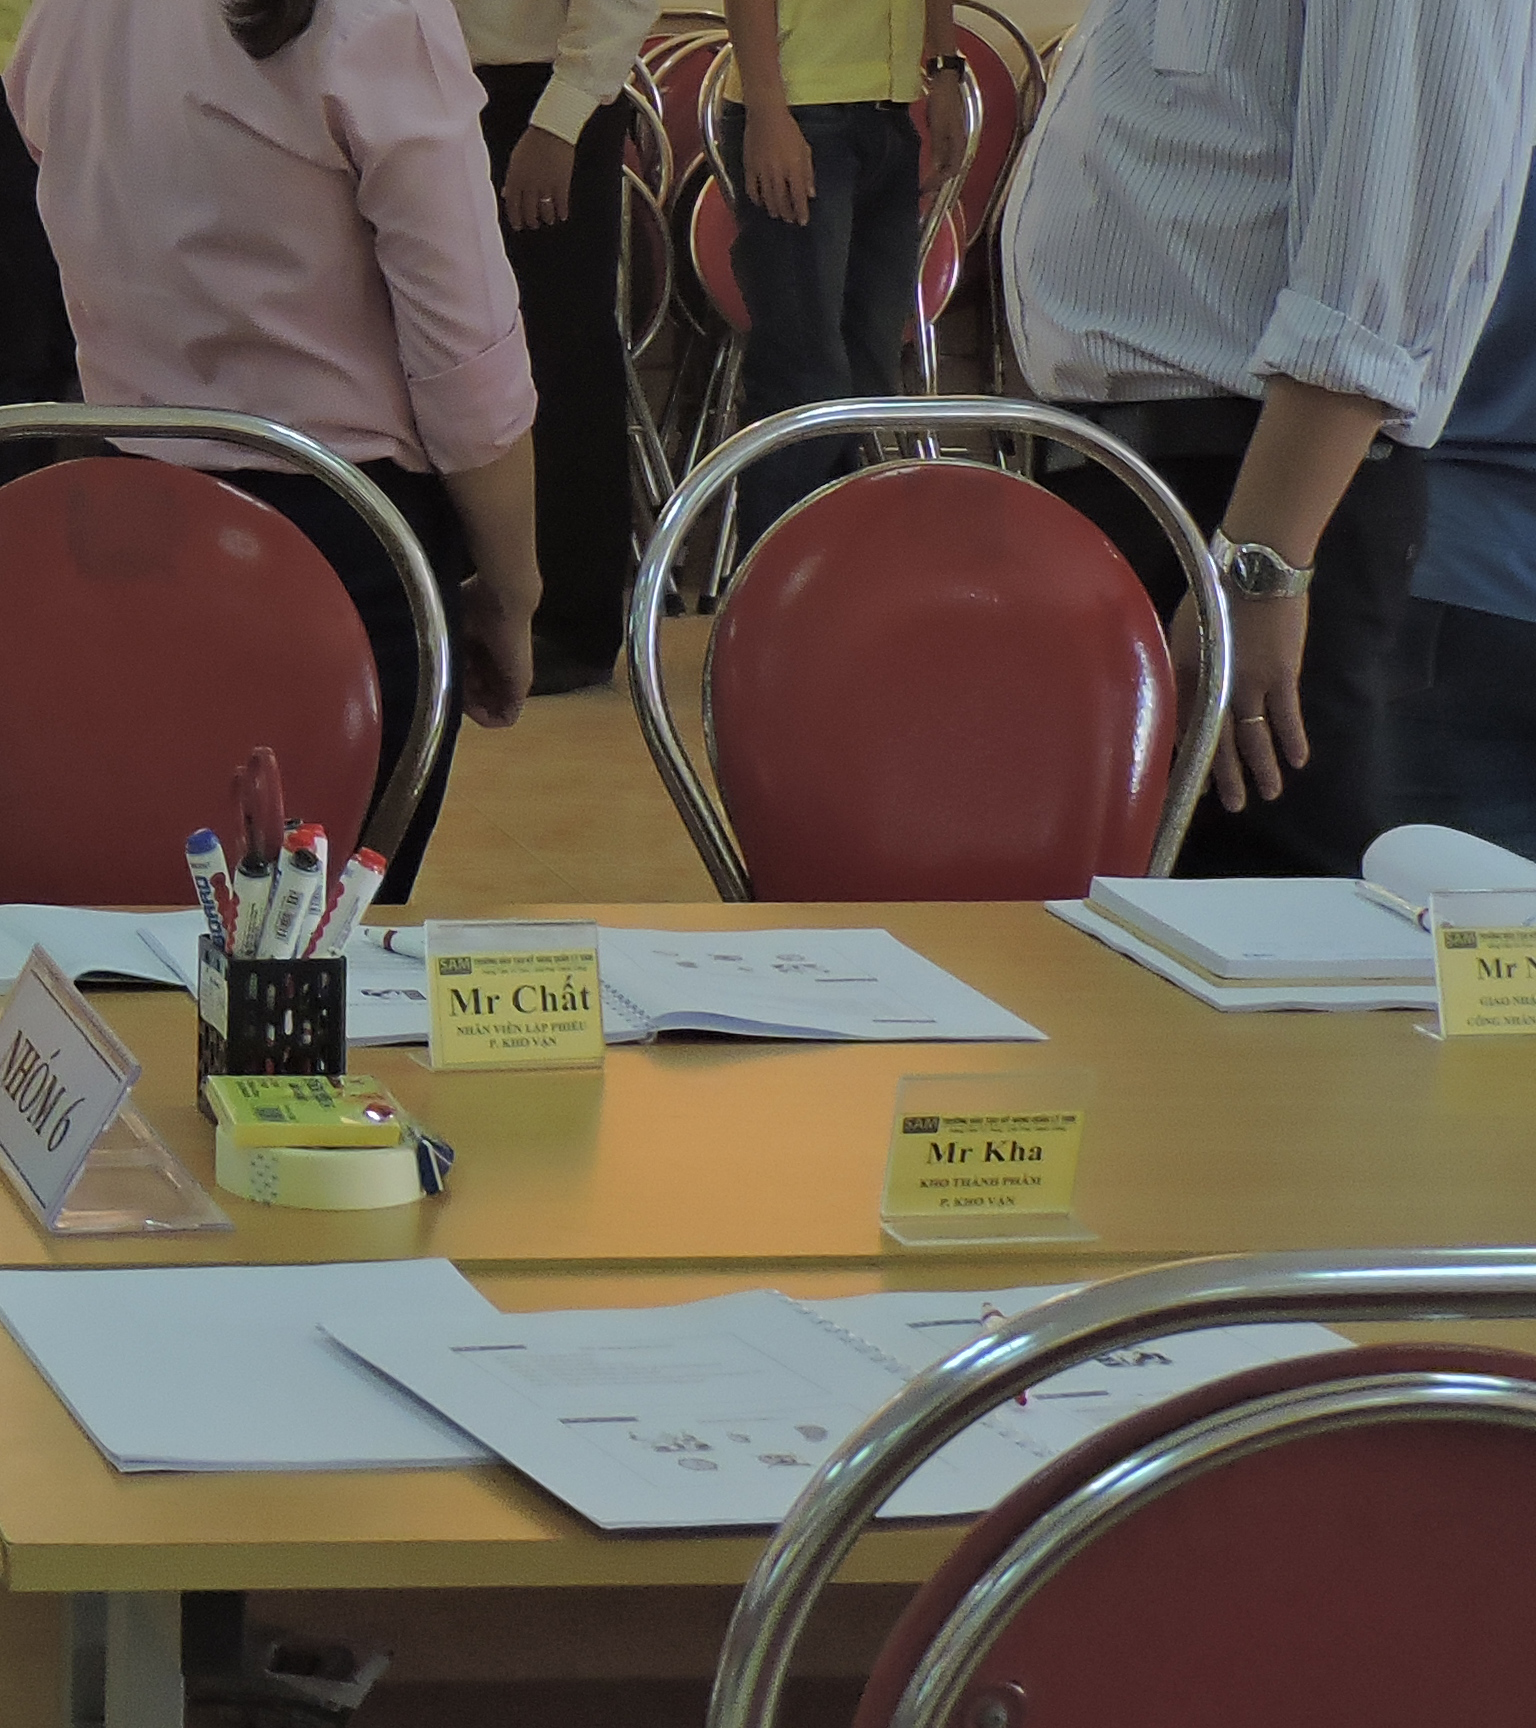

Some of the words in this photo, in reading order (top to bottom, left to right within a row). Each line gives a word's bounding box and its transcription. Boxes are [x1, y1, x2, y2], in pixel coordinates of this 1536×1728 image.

[1475, 956, 1518, 981] Mr
[448, 987, 501, 1017] Mr
[511, 974, 591, 1015] Chất
[46, 1096, 87, 1153] 6
[925, 1140, 975, 1165] Mr
[983, 1139, 1044, 1163] Kha
